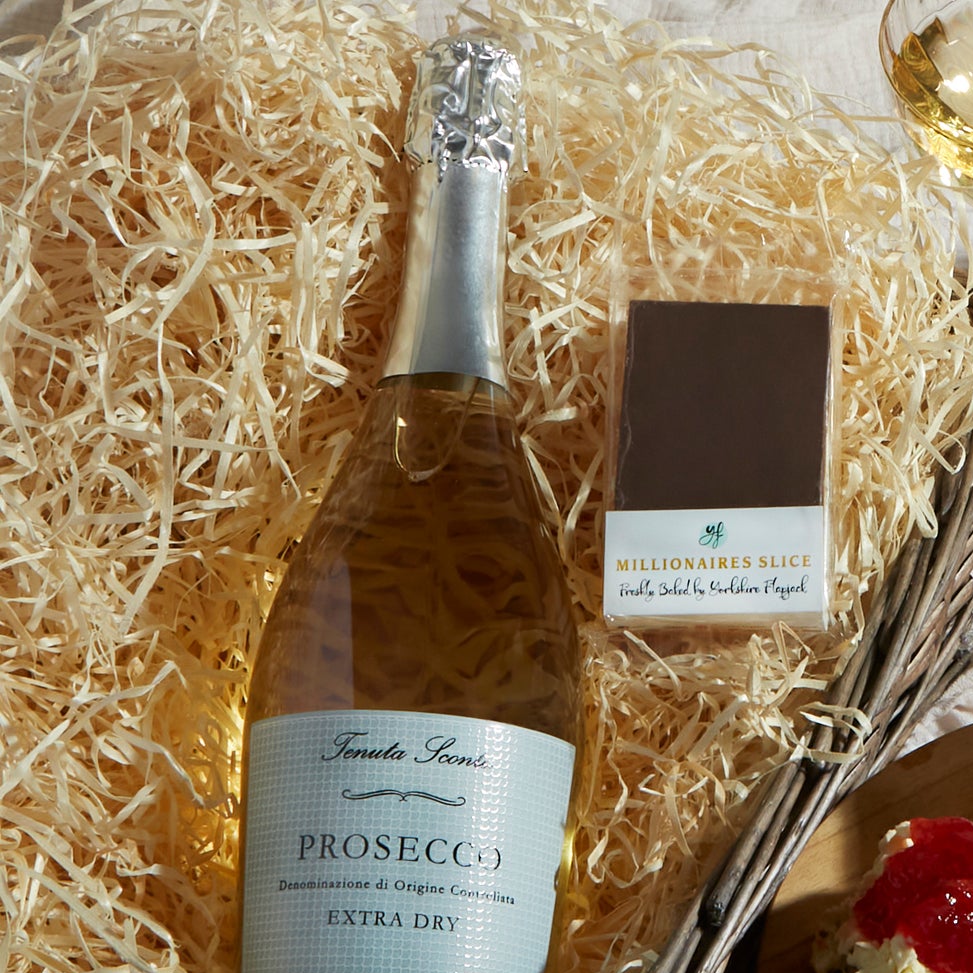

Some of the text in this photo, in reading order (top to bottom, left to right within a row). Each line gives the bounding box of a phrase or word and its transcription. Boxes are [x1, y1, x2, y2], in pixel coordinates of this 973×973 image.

[616, 555, 812, 571] MILLIONAIRES SLICE
[619, 575, 809, 602] Freshly Baked by Yorkshire Flapjack
[321, 732, 407, 761] Tenuta
[298, 834, 502, 871] PROSECCO
[279, 880, 371, 892] Denominazione
[375, 879, 389, 890] di
[394, 880, 445, 895] Origine
[326, 910, 461, 931] EXTRA DRY
